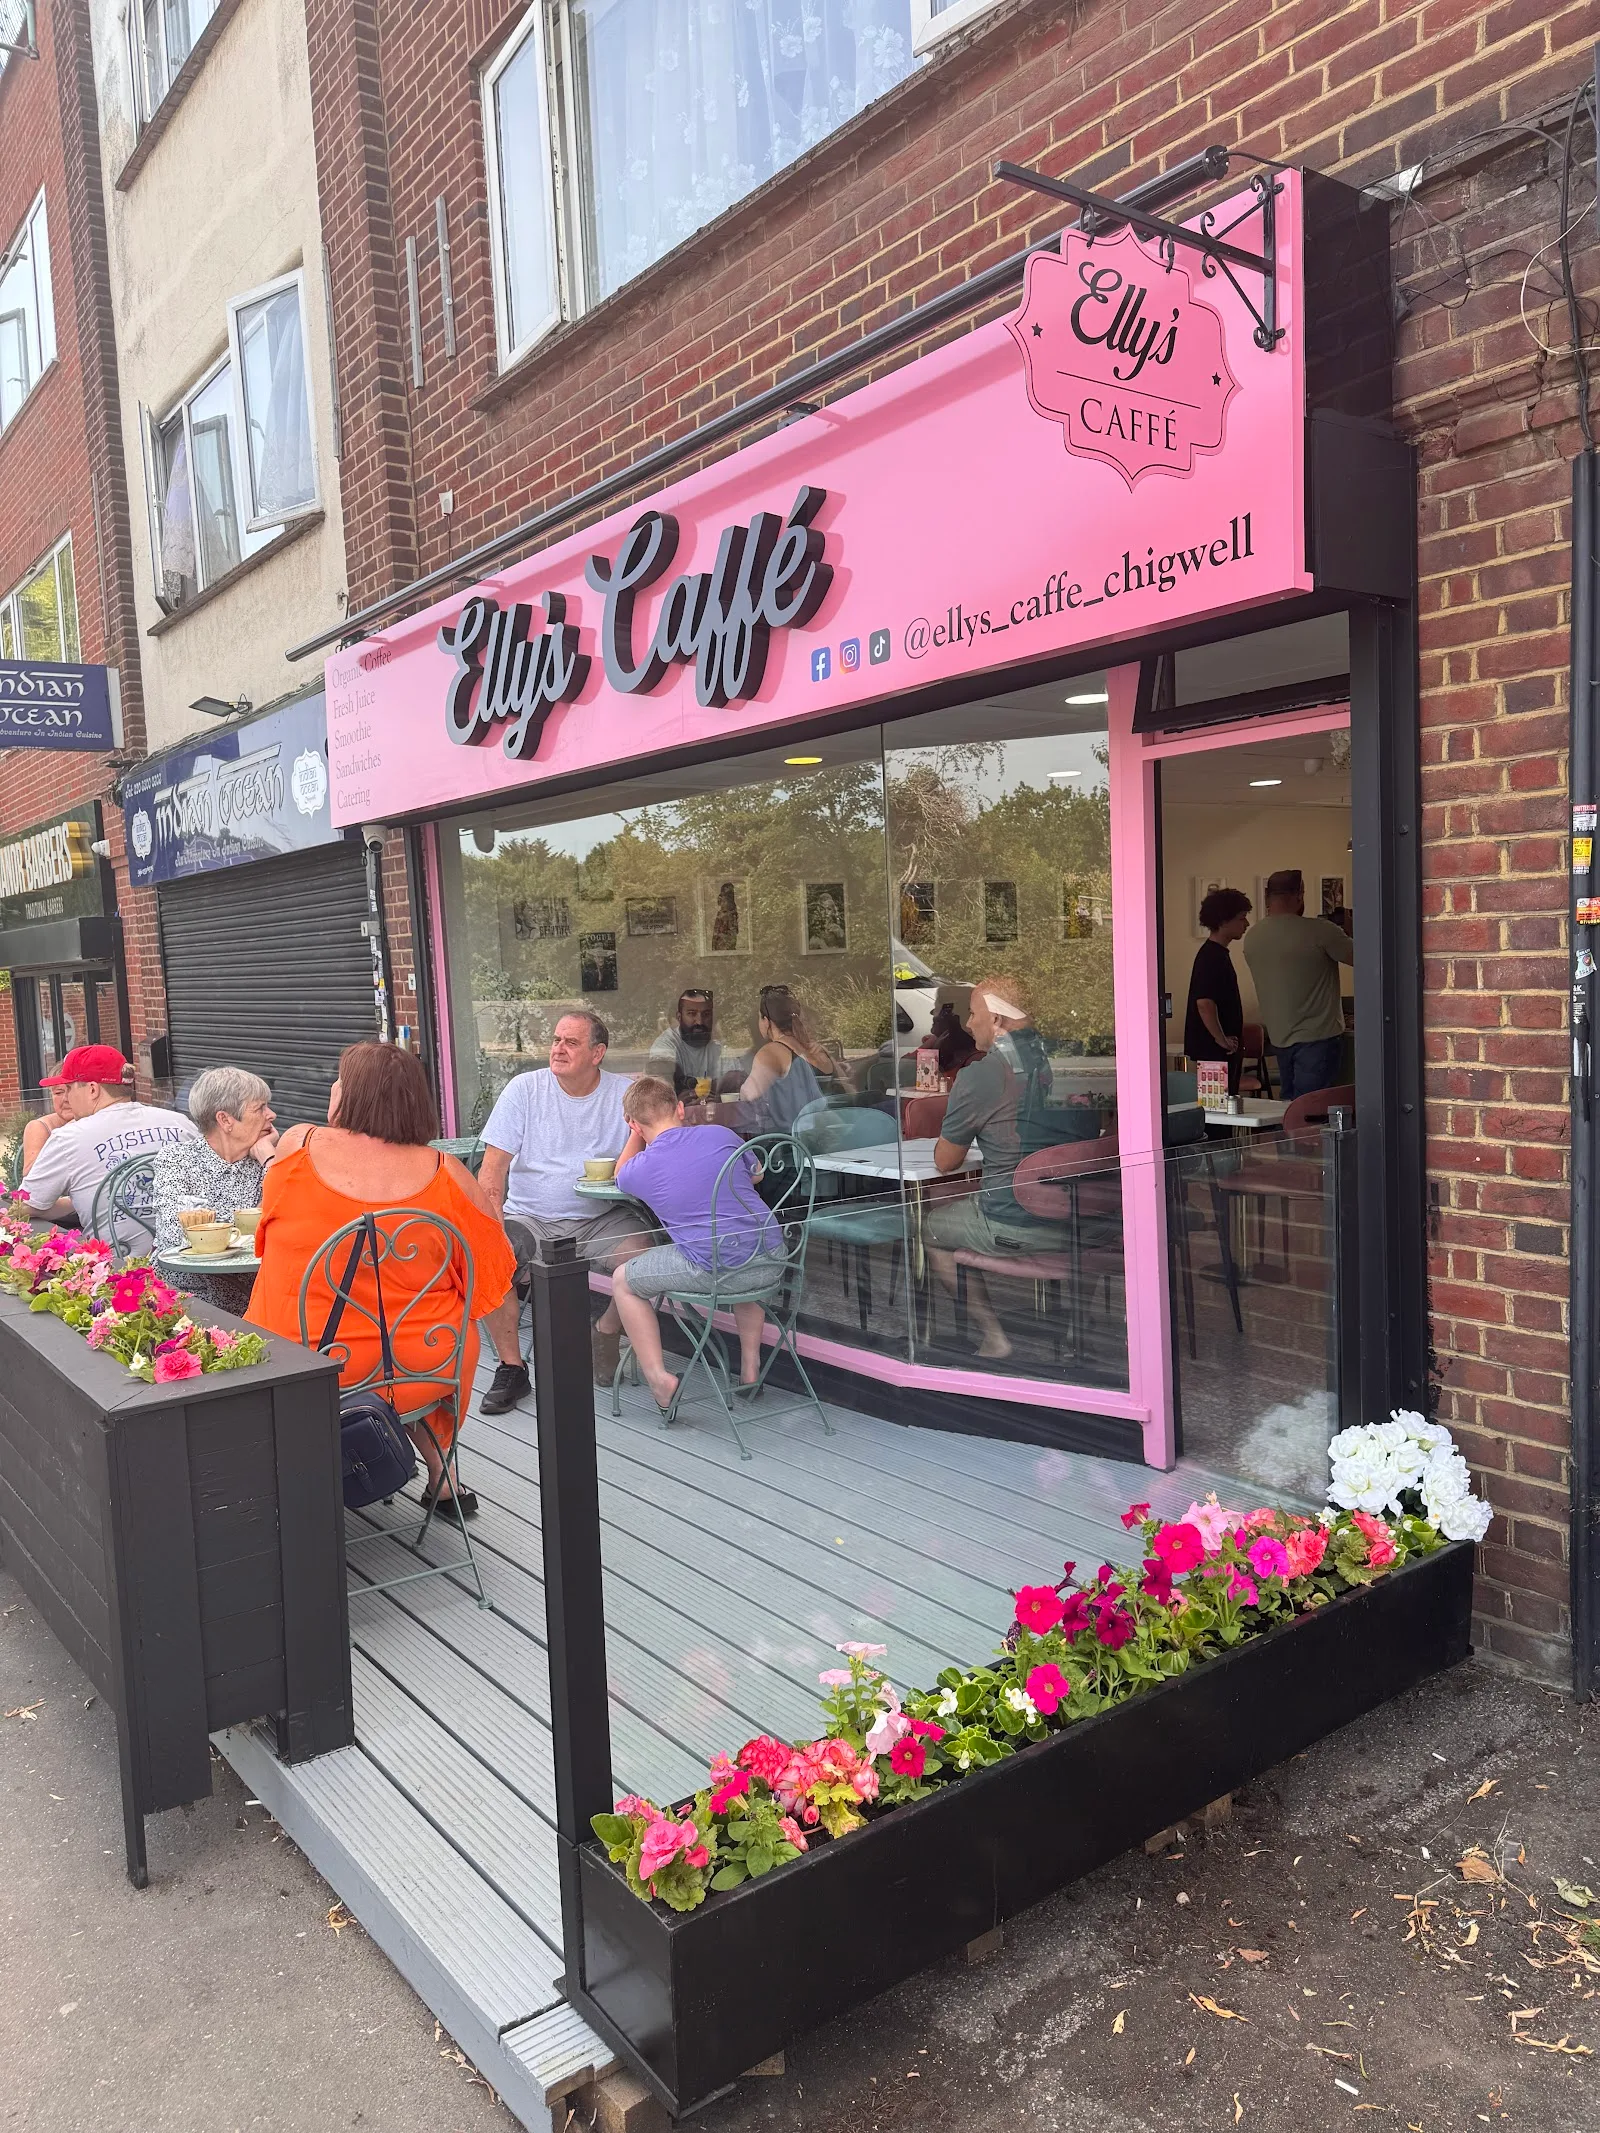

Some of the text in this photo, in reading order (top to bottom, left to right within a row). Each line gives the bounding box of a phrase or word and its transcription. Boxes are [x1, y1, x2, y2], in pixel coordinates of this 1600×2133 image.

[1070, 261, 1179, 381] Elly's
[1080, 398, 1178, 451] CAFFÉ
[903, 511, 1255, 660] @ellys_caffe_chigwell
[437, 485, 834, 761] Elly's Caffé
[0, 671, 84, 698] ndian
[332, 646, 392, 689] Organic Coffee
[333, 688, 376, 719] Fresh Juice
[0, 728, 32, 737] dventure
[334, 720, 372, 750] Smoothie
[335, 750, 382, 780] Sandwiches
[336, 786, 371, 811] Catering
[0, 822, 73, 898] ANOR BARBERS
[93, 1127, 184, 1162] PUSHIN'
